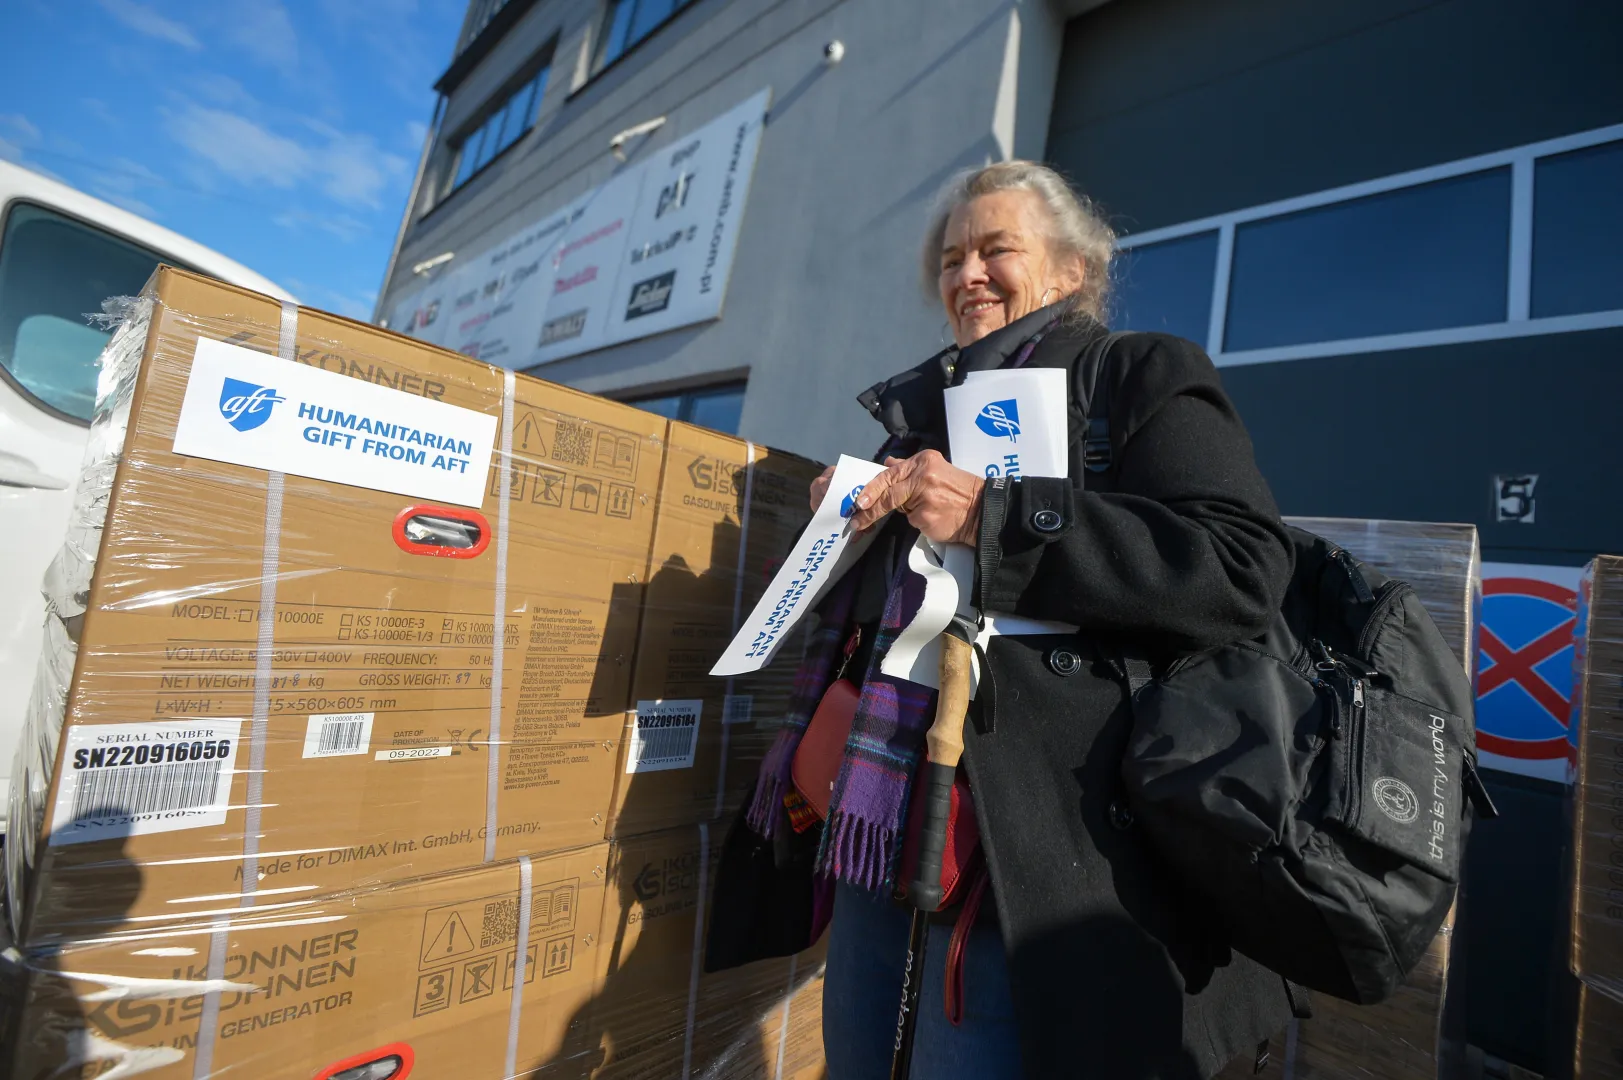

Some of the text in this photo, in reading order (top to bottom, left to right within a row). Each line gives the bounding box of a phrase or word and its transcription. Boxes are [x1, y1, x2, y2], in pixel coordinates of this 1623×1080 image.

[222, 388, 286, 422] aft
[298, 402, 472, 457] HUMANITARIAN
[303, 426, 470, 474] GIFT FROM AFT
[683, 495, 730, 514] GASOLINE
[745, 538, 825, 658] GIFT FROM AFT
[756, 533, 840, 657] HUMANITARIAN
[278, 611, 325, 625] 10000E
[356, 615, 425, 629] KS 10000E-3
[354, 628, 434, 642] KS 10000E-1/3
[456, 621, 467, 632] KS
[503, 624, 519, 634] ATS
[454, 634, 465, 644] KS
[506, 635, 520, 646] ATS
[165, 647, 352, 664] VOLTAGE: 30V 400V
[363, 652, 437, 666] FREQUENCY:
[468, 655, 480, 665] 50
[160, 673, 195, 689] NET
[308, 674, 324, 690] kg
[359, 673, 400, 686] GROSS
[403, 673, 451, 686] WEIGHT:
[479, 674, 492, 688] kg
[369, 698, 397, 709] mm
[96, 729, 214, 744] SERIAL NUMBER
[392, 736, 440, 746] PRODUCTION
[393, 729, 424, 738] DATE OF
[73, 739, 231, 770] SN220916056
[389, 748, 440, 759] 09-2022
[1428, 714, 1449, 860] this is my world
[296, 854, 324, 871] for
[327, 842, 388, 866] DIMAX
[392, 838, 418, 855] Int.
[422, 829, 474, 850] GmbH,
[477, 821, 541, 840] Grmany.
[425, 974, 445, 1001] 3
[220, 990, 354, 1040] GENERATOR
